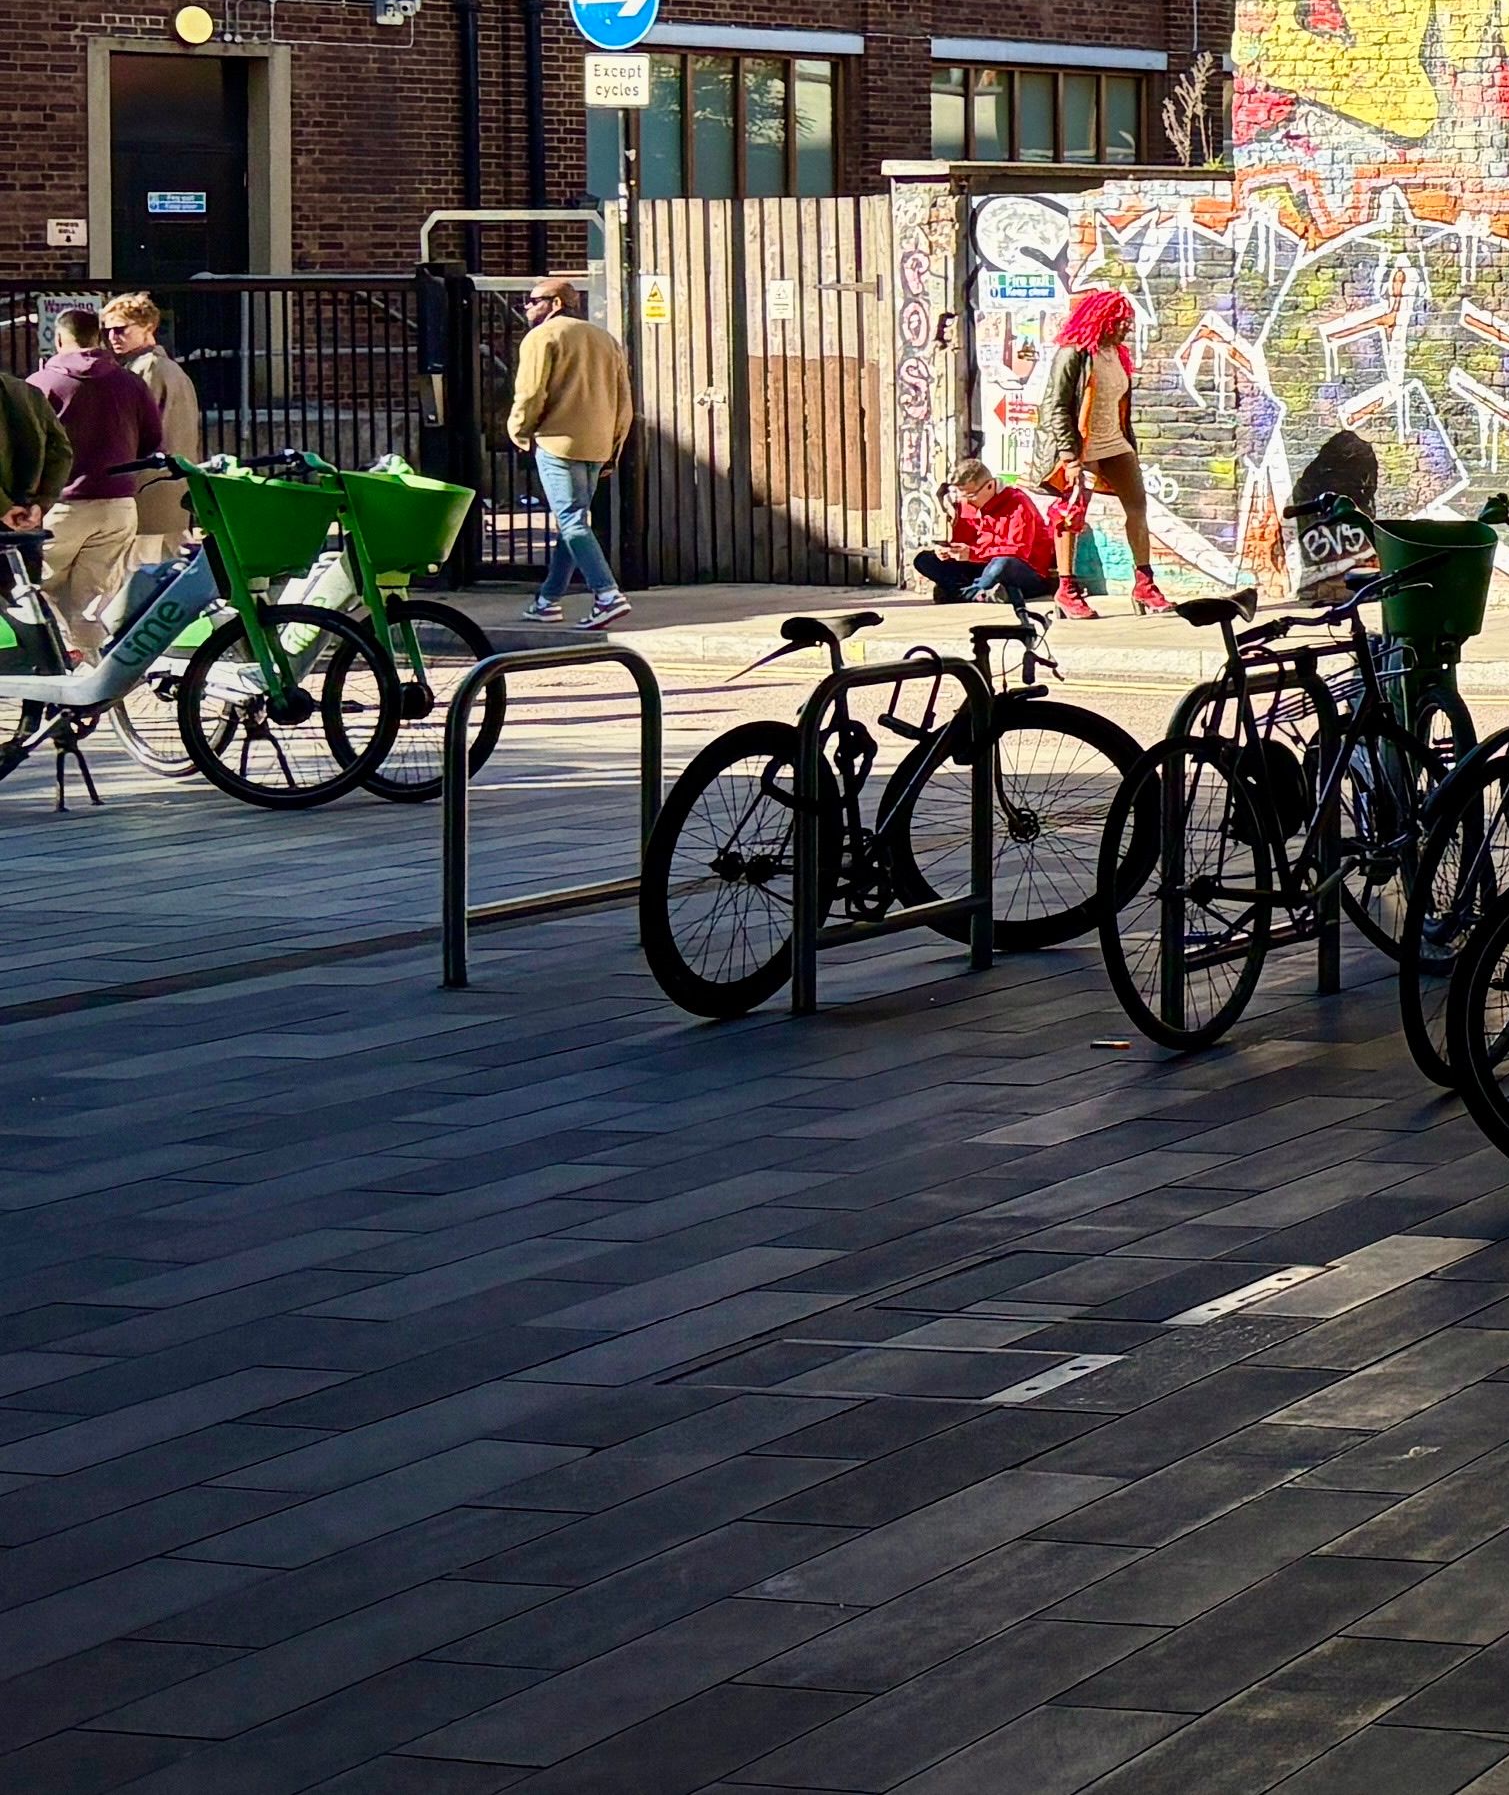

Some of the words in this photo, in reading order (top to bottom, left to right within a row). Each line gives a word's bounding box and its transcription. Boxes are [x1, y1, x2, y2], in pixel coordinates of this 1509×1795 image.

[593, 64, 642, 79] Except
[596, 84, 639, 98] cycles
[115, 600, 184, 666] Lime
